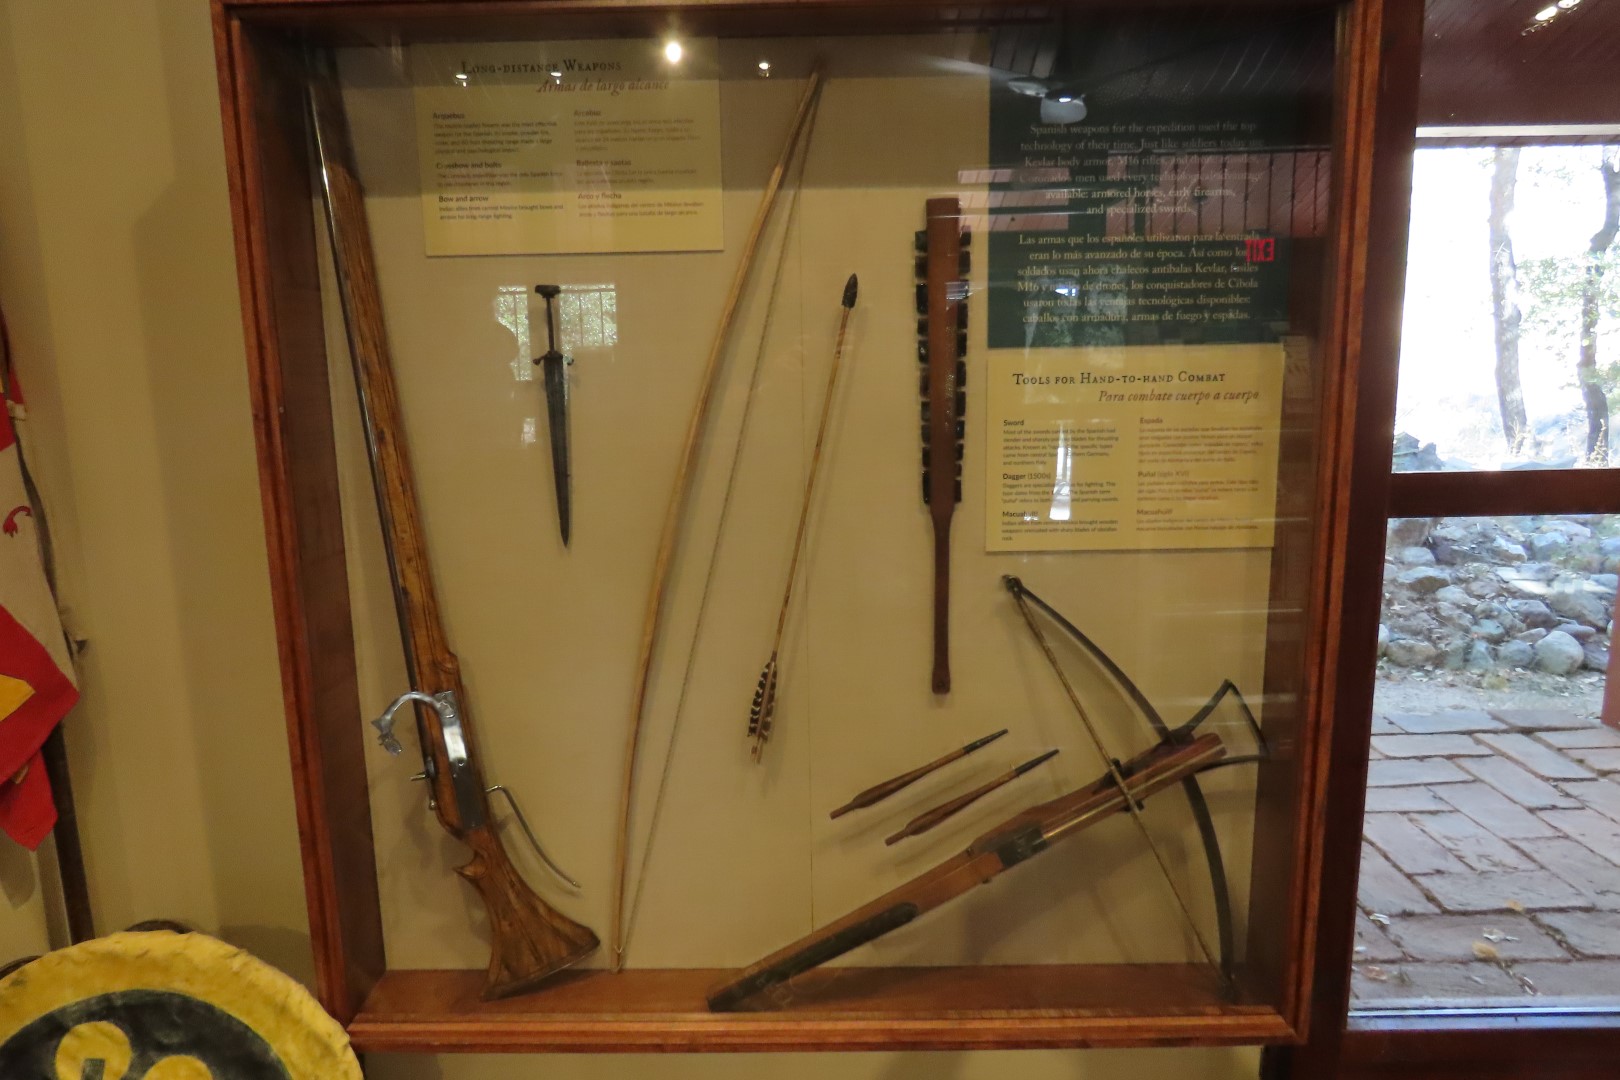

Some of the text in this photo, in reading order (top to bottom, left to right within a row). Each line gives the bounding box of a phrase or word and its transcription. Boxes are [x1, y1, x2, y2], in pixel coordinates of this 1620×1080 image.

[564, 59, 623, 71] WEAPONS
[537, 79, 575, 93] Armas
[580, 78, 593, 91] de
[597, 78, 625, 96] largo
[1030, 124, 1067, 136] Spanish
[1070, 125, 1109, 136] weapons
[1112, 124, 1126, 132] for
[1129, 123, 1144, 132] the
[1146, 121, 1195, 135] expedition
[1223, 120, 1238, 130] the
[1020, 141, 1071, 152] technology
[1075, 140, 1085, 149] of
[1088, 140, 1110, 149] their
[1138, 138, 1158, 150] Just
[1161, 138, 1178, 148] like
[1025, 157, 1054, 167] Kevlar
[1058, 156, 1080, 168] body
[1122, 174, 1147, 184] every
[1091, 187, 1131, 198] armored
[1134, 187, 1165, 198] horses,
[1087, 204, 1104, 214] and
[1106, 203, 1157, 216] specialized
[1019, 231, 1259, 246] Las armas que los españoles utilizaron para la entrada
[1052, 250, 1061, 259] lo
[1064, 251, 1082, 259] más
[1085, 248, 1128, 259] avanzado
[1130, 249, 1141, 258] de
[1156, 248, 1185, 260] época.
[1188, 247, 1205, 257] Así
[1207, 249, 1232, 257] como
[1017, 266, 1056, 276] soldados
[1059, 267, 1080, 276] usan
[1083, 265, 1108, 274] ahora
[1110, 264, 1149, 274] chalecos
[1195, 262, 1227, 274] Kevlar,
[1017, 282, 1039, 291] M16
[1083, 281, 1094, 290] de
[1096, 281, 1129, 291] drones,
[1131, 281, 1144, 289] los
[1146, 279, 1212, 292] conquistadores
[1215, 278, 1225, 288] de
[1023, 299, 1054, 307] usaron
[1085, 297, 1097, 306] las
[1139, 295, 1194, 307] tecnológicas
[1197, 294, 1250, 307] disponibles:
[1023, 312, 1058, 323] caballos
[1081, 312, 1128, 322] armadura,
[1132, 313, 1159, 321] armas
[1162, 311, 1173, 320] de
[1176, 311, 1202, 322] fuego
[1204, 312, 1210, 322] y
[1213, 311, 1250, 322] espadas.
[1013, 371, 1226, 385] TOOLS FOR HAND-TO-HAND COMBAT
[1099, 390, 1124, 402] Para
[1128, 389, 1173, 401] combate
[1176, 392, 1210, 405] cuerpo
[1223, 391, 1259, 405] cuerpo
[1003, 473, 1026, 481] Dagger
